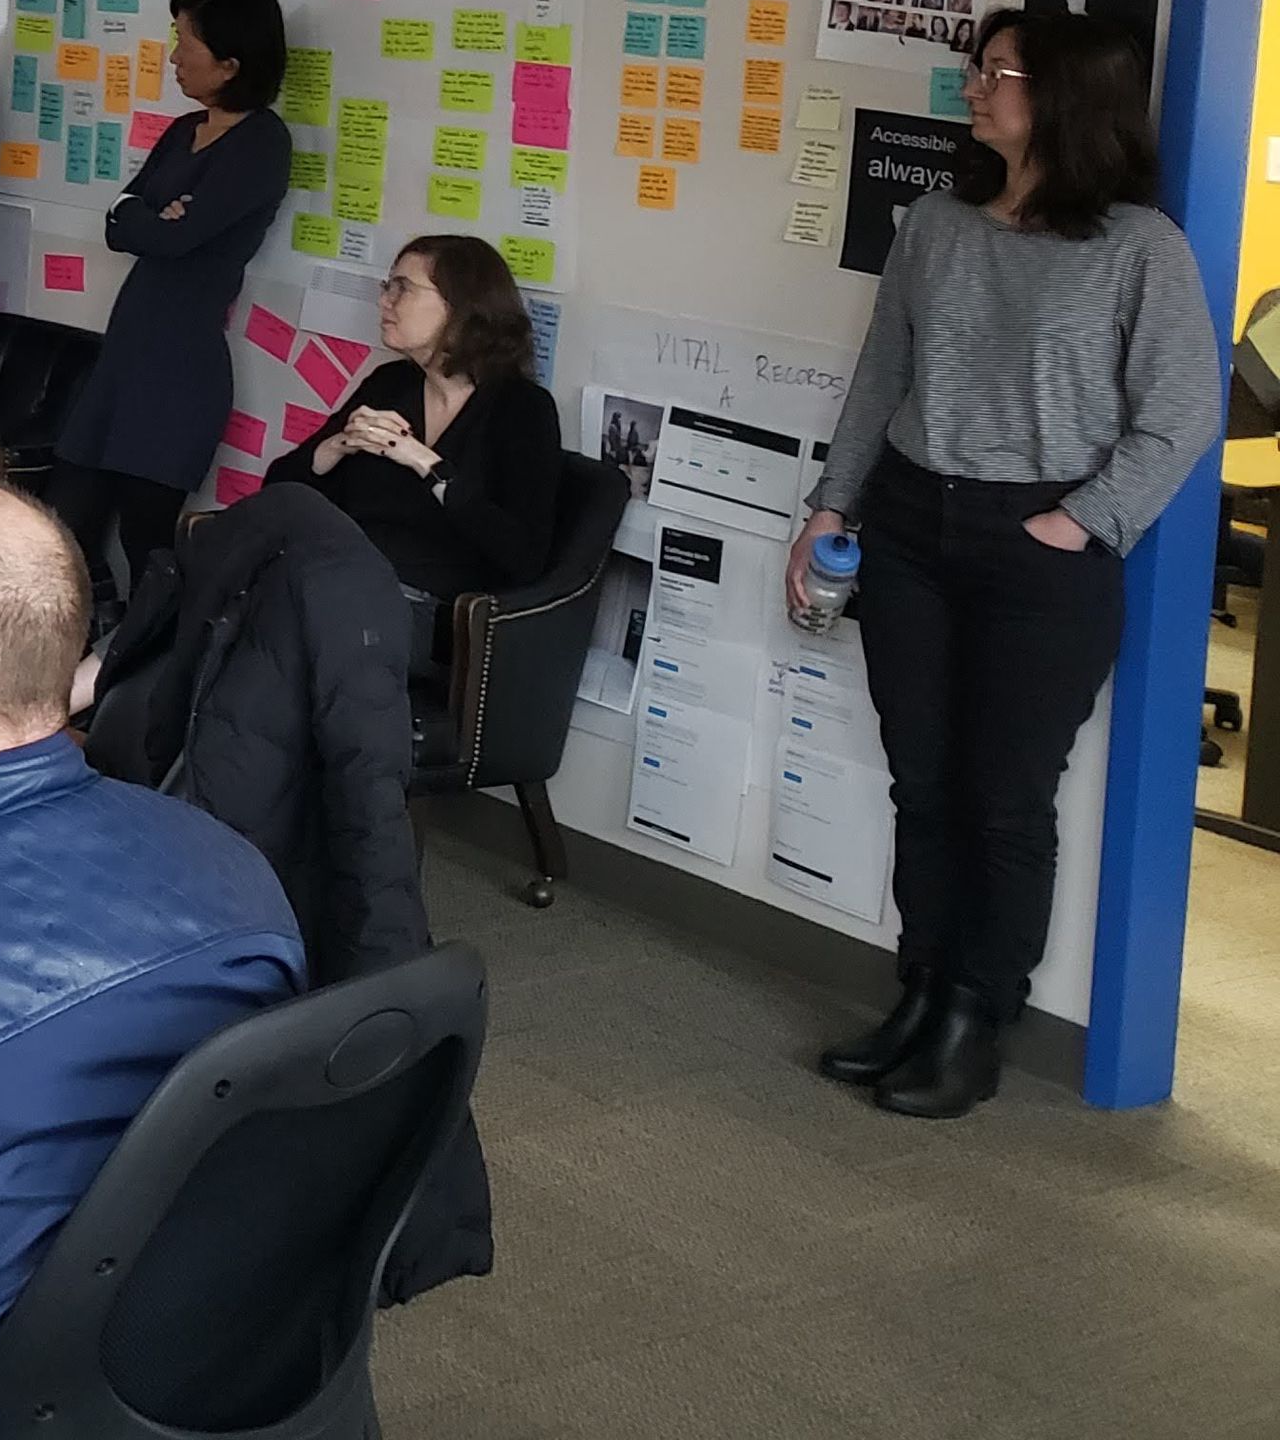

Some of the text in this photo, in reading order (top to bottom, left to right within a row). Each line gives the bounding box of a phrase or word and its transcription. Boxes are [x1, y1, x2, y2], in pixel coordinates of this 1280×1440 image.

[870, 126, 957, 153] Accessible
[868, 155, 955, 192] always
[656, 333, 846, 400] VITAL RECORDS
[719, 385, 736, 408] A
